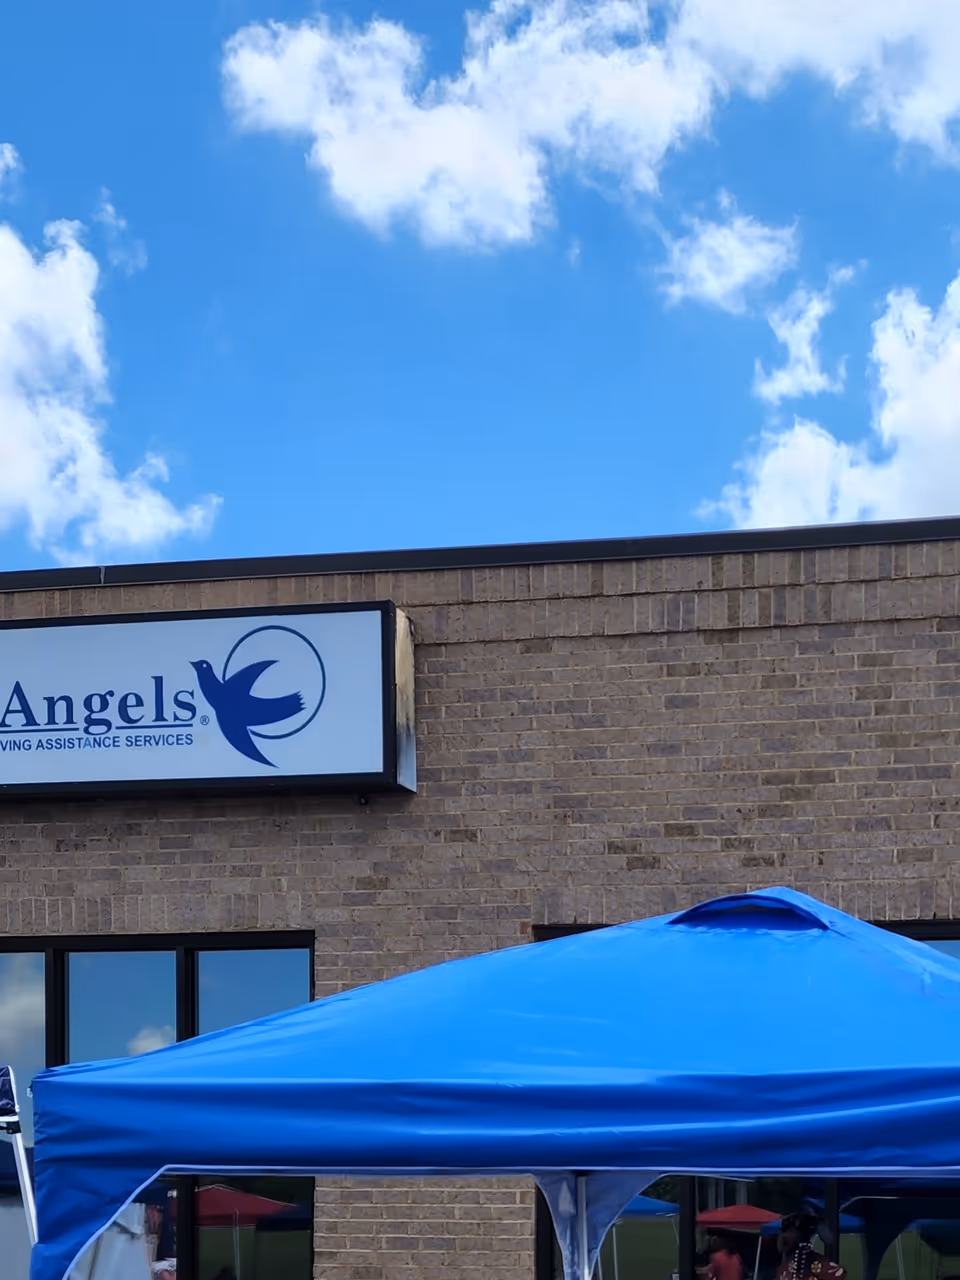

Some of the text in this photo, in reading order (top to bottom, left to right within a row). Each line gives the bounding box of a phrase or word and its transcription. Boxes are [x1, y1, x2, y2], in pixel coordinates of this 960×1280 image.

[0, 676, 197, 735] Angels
[36, 736, 120, 750] ASSISTANCE
[125, 733, 194, 748] SERVICES
